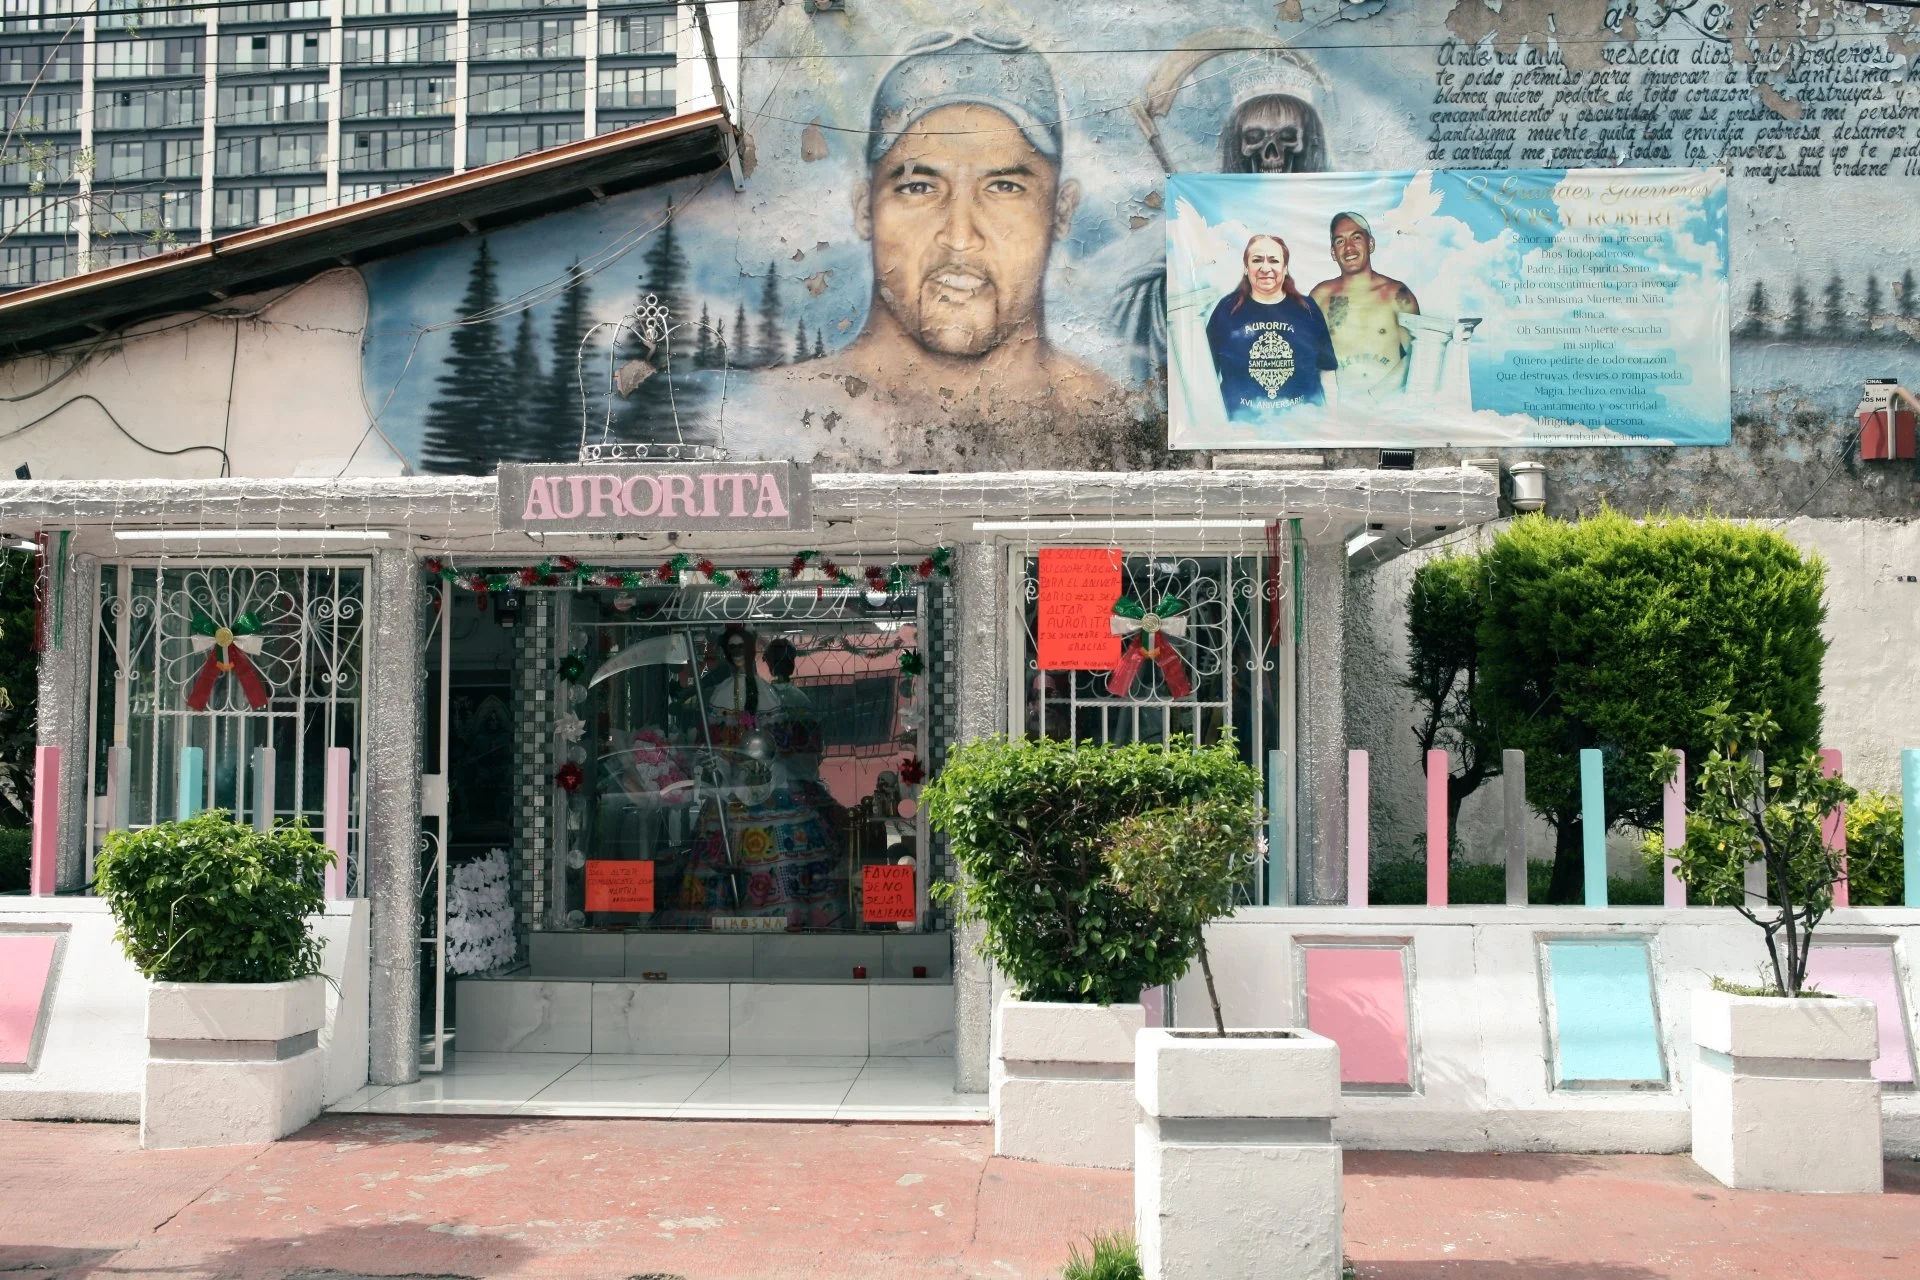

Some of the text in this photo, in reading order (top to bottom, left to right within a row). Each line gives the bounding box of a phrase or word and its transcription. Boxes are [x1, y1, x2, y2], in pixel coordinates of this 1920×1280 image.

[1438, 39, 1492, 66] Ante
[1691, 41, 1731, 65] dios
[1436, 68, 1455, 86] te
[1460, 67, 1504, 90] pido
[1511, 66, 1583, 90] permiso
[1587, 69, 1631, 90] para
[1641, 68, 1710, 86] invocar
[1433, 86, 1488, 105] blanca
[1494, 87, 1544, 109] quiero
[1551, 84, 1611, 108] pedirte
[1617, 85, 1634, 102] de
[1643, 83, 1678, 103] todo
[1686, 87, 1750, 103] corazon
[1430, 103, 1555, 123] encantamiento
[1577, 102, 1659, 122] oscuridad
[1669, 108, 1693, 128] que
[1700, 106, 1718, 121] se
[1857, 104, 1920, 128] person
[1527, 122, 1588, 141] muerte
[1833, 121, 1906, 140] desamor
[1428, 139, 1920, 165] de caridad me concedas todos los favores que yo te pid
[1744, 159, 1822, 184] majestad
[1834, 159, 1888, 177] ordene
[1582, 233, 1613, 244] divina
[1541, 249, 1562, 259] Dios
[1513, 279, 1536, 291] pido
[1538, 280, 1612, 289] consentimiento
[1616, 281, 1638, 291] para
[1244, 321, 1295, 334] AURORITA
[1584, 325, 1618, 334] Muerte
[1563, 339, 1576, 350] mi
[1271, 359, 1295, 368] MUERTE
[1513, 355, 1547, 367] Quiero
[1586, 355, 1599, 365] de
[1602, 355, 1625, 364] todo
[1496, 371, 1517, 382] Que
[1621, 372, 1658, 382] rompas
[1240, 397, 1253, 408] XVI
[1523, 401, 1596, 411] Encantamiento
[1608, 401, 1657, 410] oscuridad
[522, 473, 789, 520] AURORITA
[1047, 604, 1083, 615] ALTAR
[1047, 616, 1110, 629] AURORITA
[1067, 641, 1108, 651] GRACIAS
[863, 865, 910, 879] FAVOR
[865, 881, 903, 892] DE NO
[865, 894, 904, 905] DEJAR
[714, 918, 782, 930] LIMOSNA
